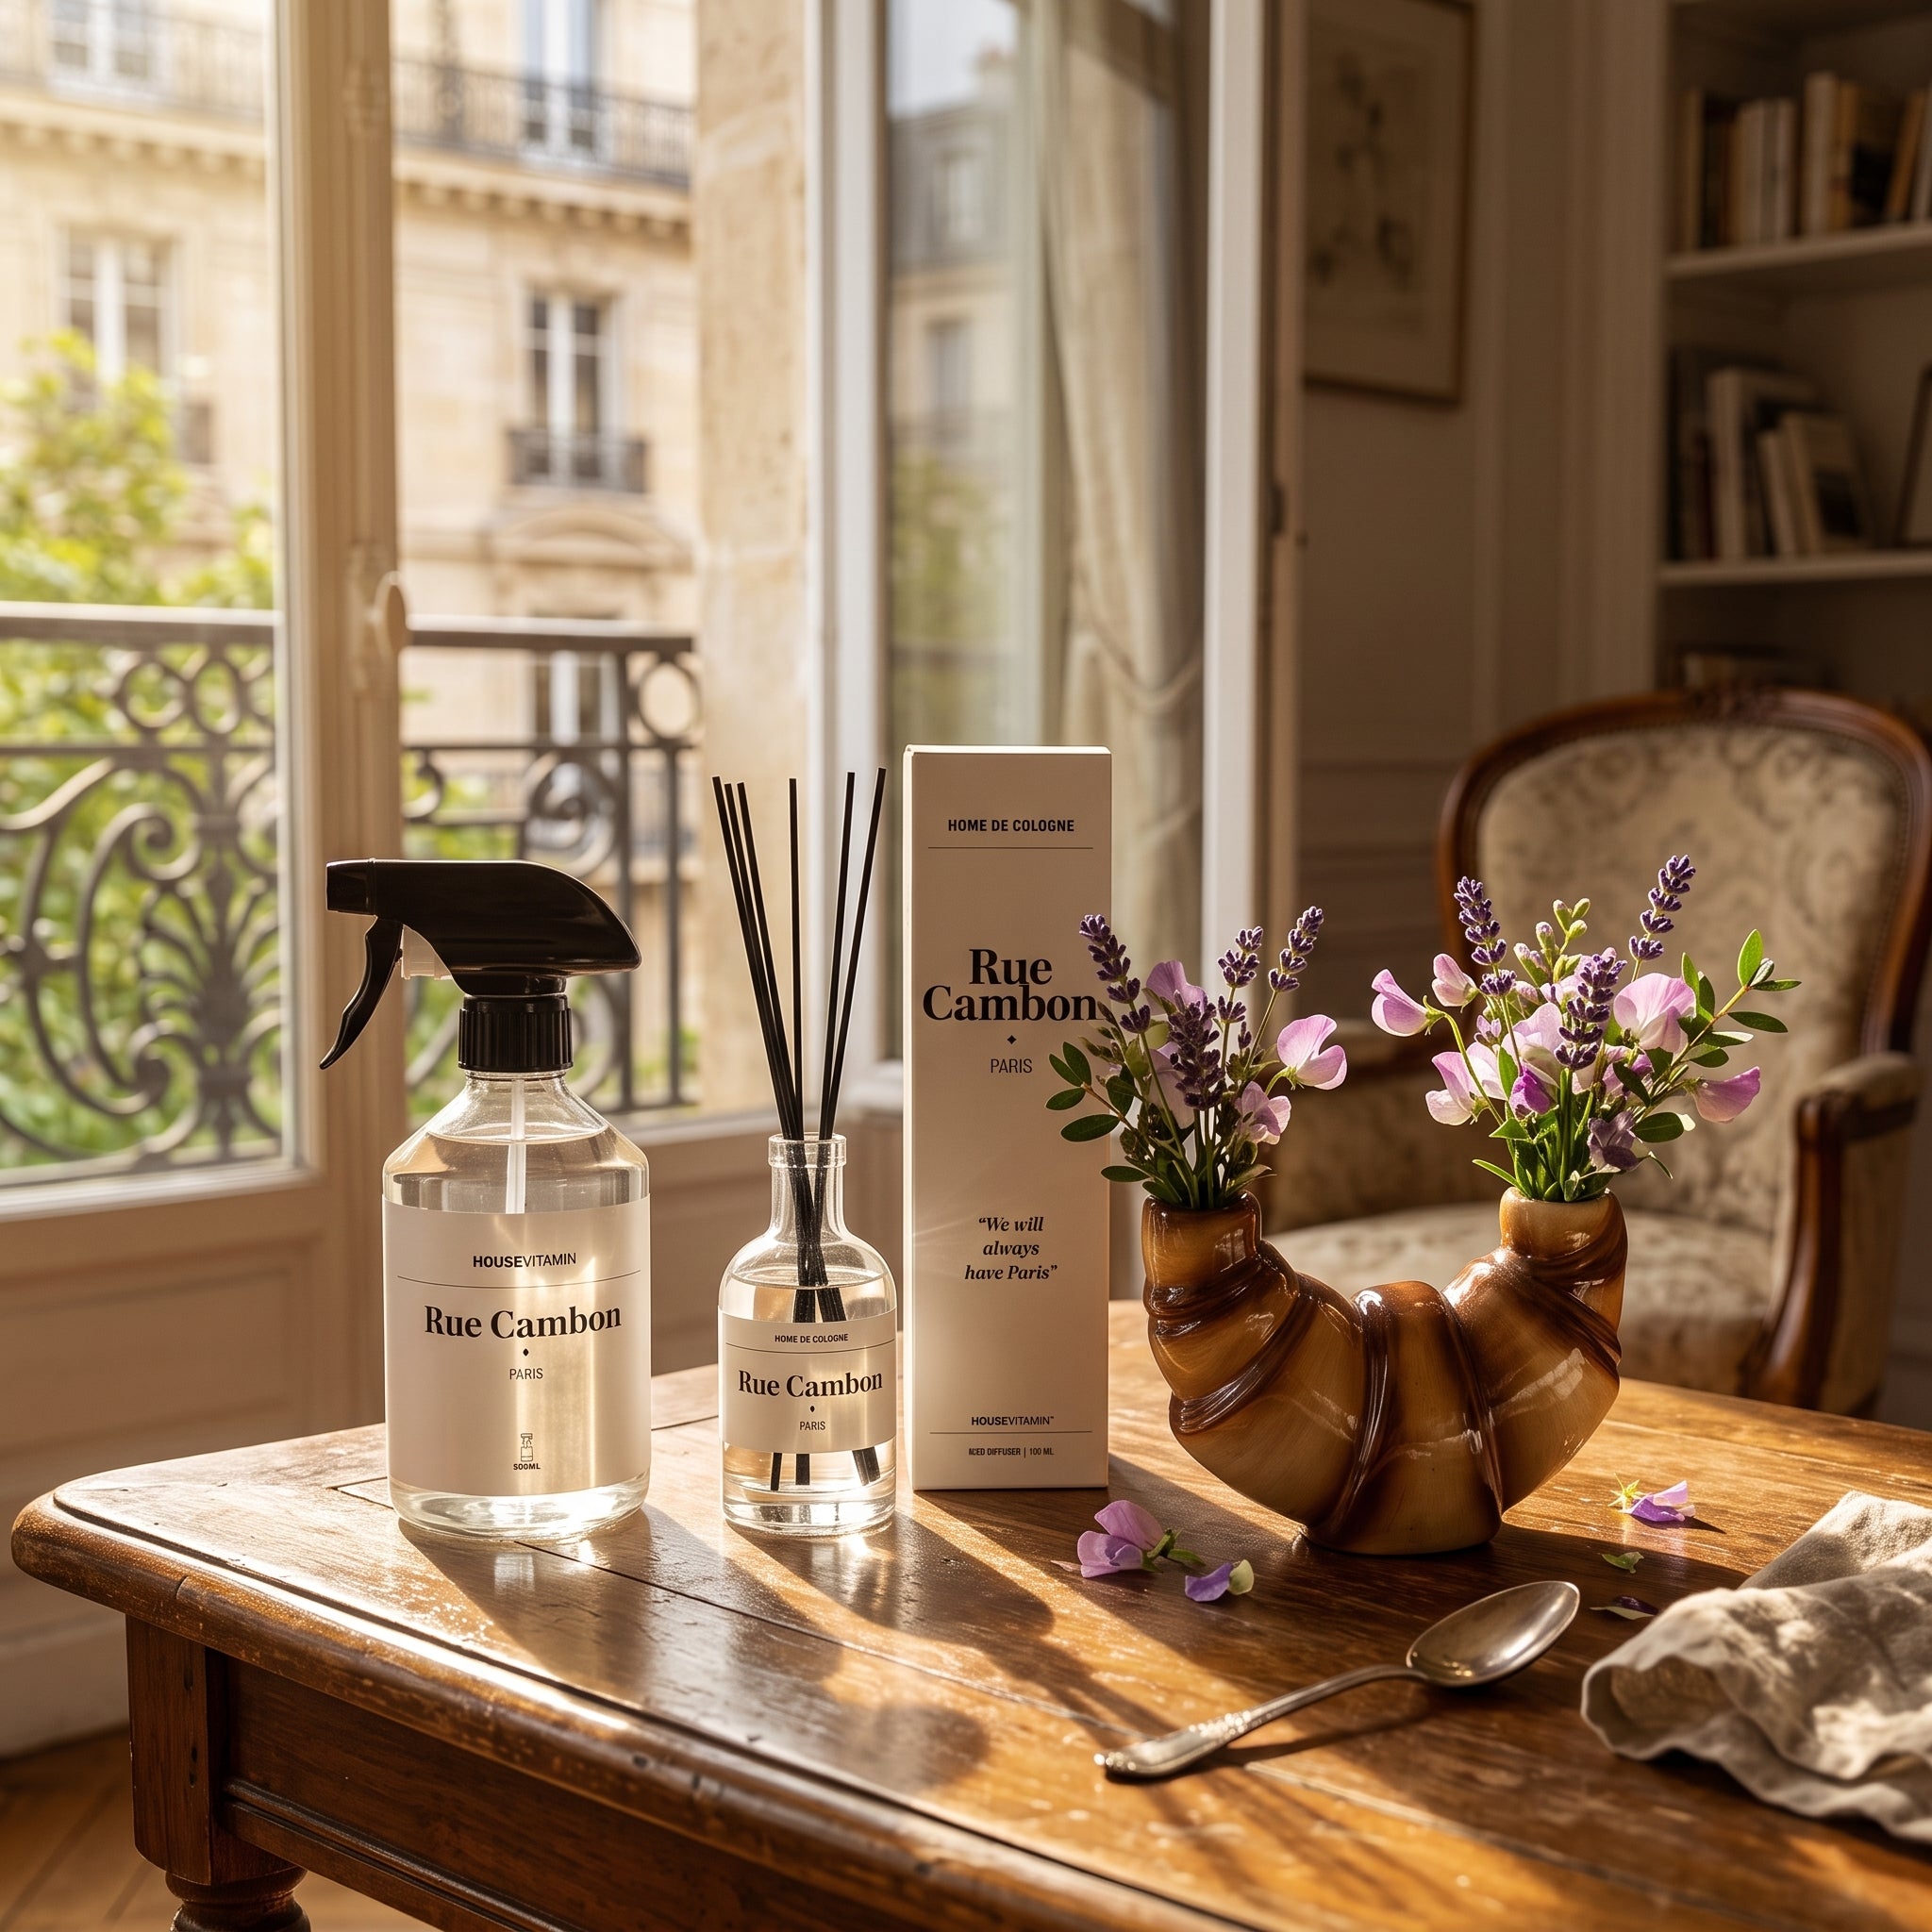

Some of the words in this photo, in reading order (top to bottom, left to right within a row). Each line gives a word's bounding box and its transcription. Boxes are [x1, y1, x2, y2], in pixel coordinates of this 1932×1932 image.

[948, 820, 987, 832] HOME
[991, 820, 1008, 832] DE
[1012, 820, 1074, 832] COLOGNE
[969, 949, 1053, 985] Rue
[923, 985, 1105, 1022] Cambon
[991, 1058, 1033, 1074] PARIS
[978, 1217, 1009, 1231] “We
[1014, 1217, 1043, 1231] will
[982, 1241, 1040, 1258] always
[473, 1253, 576, 1268] HOUSEVITAMIN
[964, 1265, 1003, 1280] have
[1007, 1265, 1058, 1280] Paris”
[425, 1306, 482, 1338] Rue
[491, 1306, 622, 1339] Cambon
[774, 1335, 798, 1343] HOME
[800, 1335, 811, 1343] DE
[812, 1333, 849, 1343] COLOGNE
[509, 1368, 543, 1380] PARIS
[739, 1370, 780, 1396] Rue
[786, 1372, 883, 1397] Cambon
[799, 1421, 826, 1431] PARIS
[987, 1447, 1021, 1456] DIFFUSER
[1029, 1447, 1041, 1456] 100
[1042, 1447, 1055, 1456] ML
